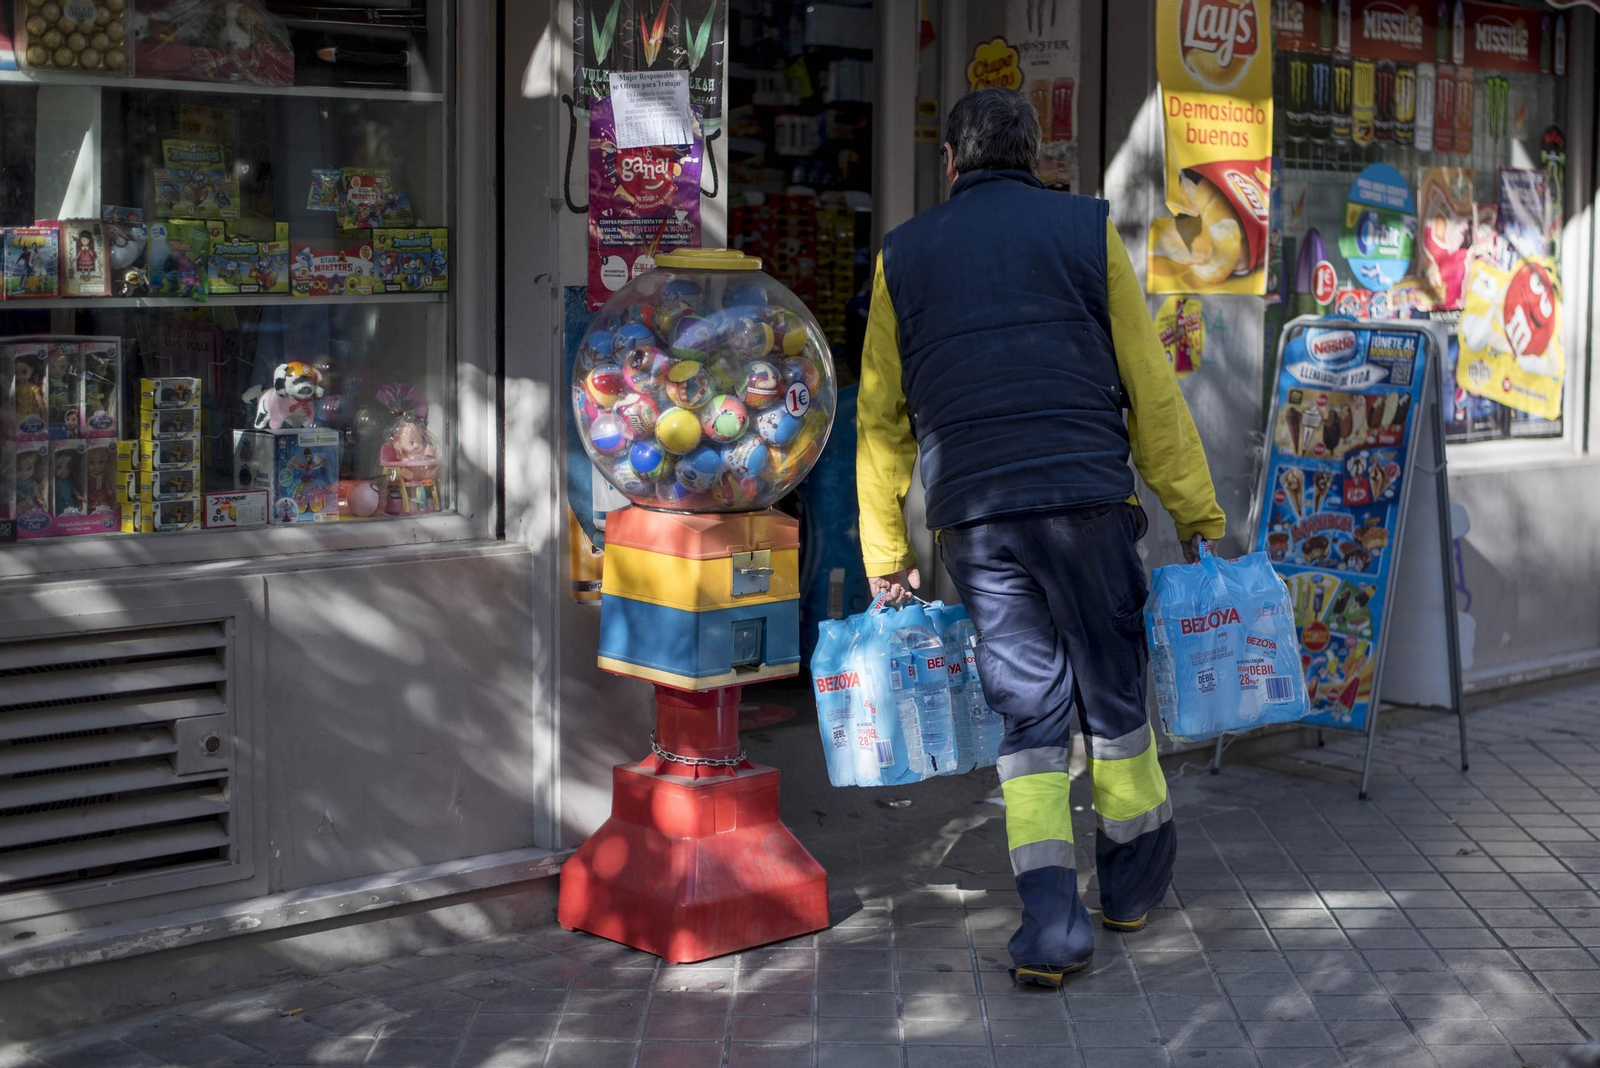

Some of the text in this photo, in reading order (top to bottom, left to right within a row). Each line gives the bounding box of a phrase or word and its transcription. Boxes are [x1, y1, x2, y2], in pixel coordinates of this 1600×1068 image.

[1184, 0, 1254, 67] Lay's
[1362, 10, 1423, 44] MISSILE
[1475, 22, 1529, 57] MISSILE
[581, 67, 610, 84] VULK
[619, 72, 675, 82] Mujer Responsable
[620, 82, 641, 90] Ofrece
[641, 82, 656, 90] para
[657, 80, 682, 88] Trabajar
[1169, 96, 1266, 125] Demasiado
[1186, 122, 1249, 148] buenas
[621, 156, 670, 182] gana!
[320, 257, 337, 265] STAR
[314, 264, 353, 273] MONSTERS
[187, 330, 197, 340] LO
[1402, 338, 1415, 350] AL
[1350, 369, 1370, 384] VIDA
[790, 389, 808, 412] 1€
[300, 435, 337, 444] Dance Princess
[1181, 607, 1241, 635] BEZOYA
[1246, 636, 1277, 650] BEZOYA
[1250, 662, 1278, 676] DÉBIL
[816, 671, 861, 693] BEZOYA
[1198, 672, 1215, 684] DÉBIL
[1239, 673, 1250, 686] 28
